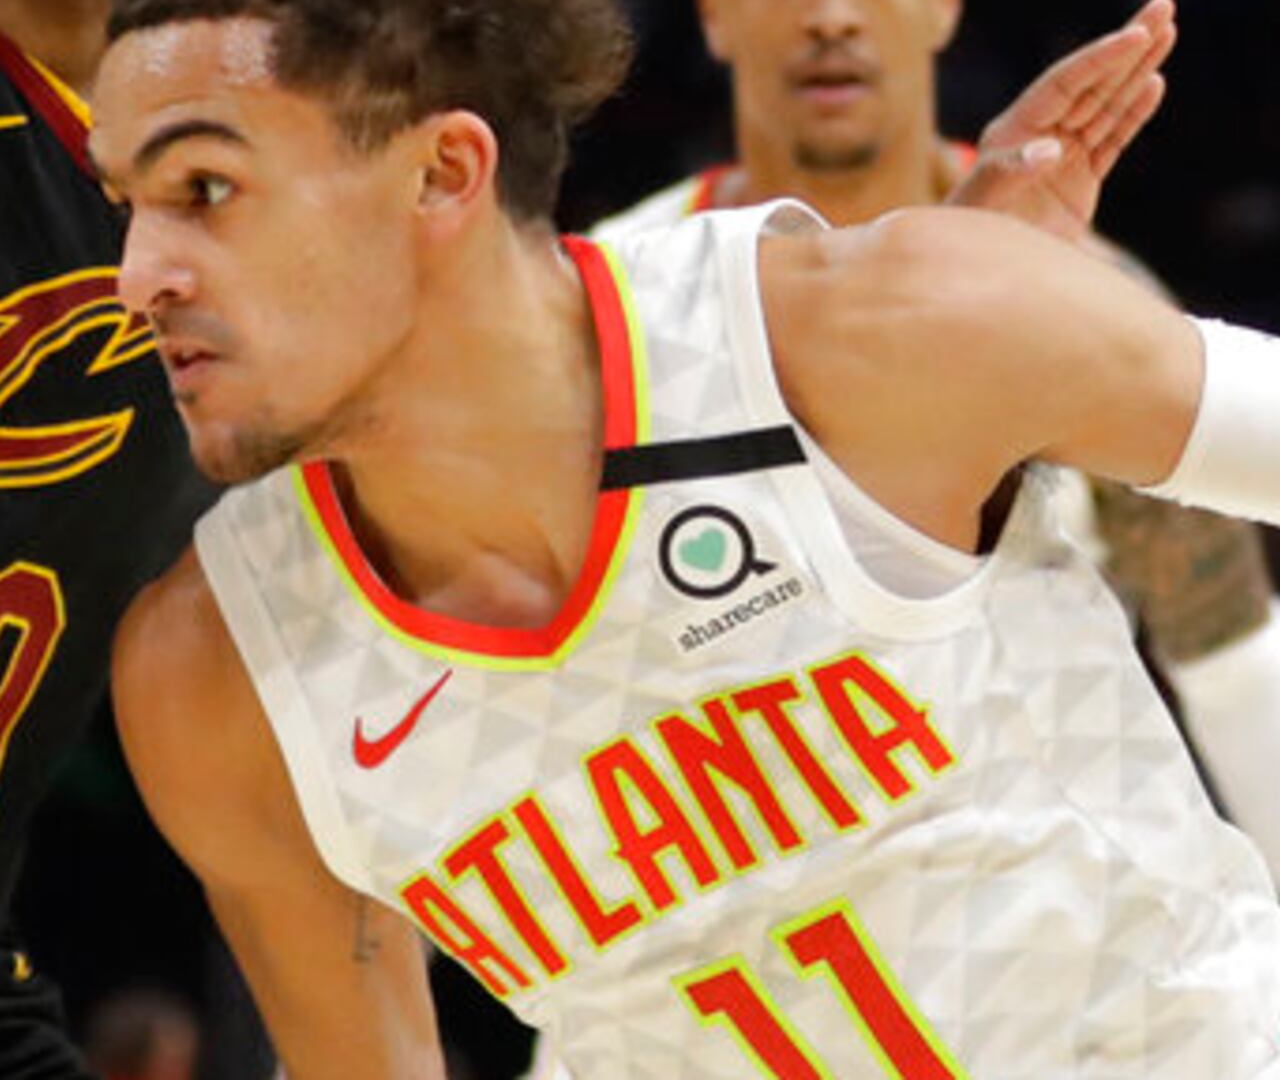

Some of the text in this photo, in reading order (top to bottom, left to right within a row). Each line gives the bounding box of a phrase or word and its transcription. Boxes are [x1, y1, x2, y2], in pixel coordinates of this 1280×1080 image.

[677, 577, 803, 652] sharecare
[397, 647, 958, 1001] ATLANTA
[673, 895, 975, 1080] 11
